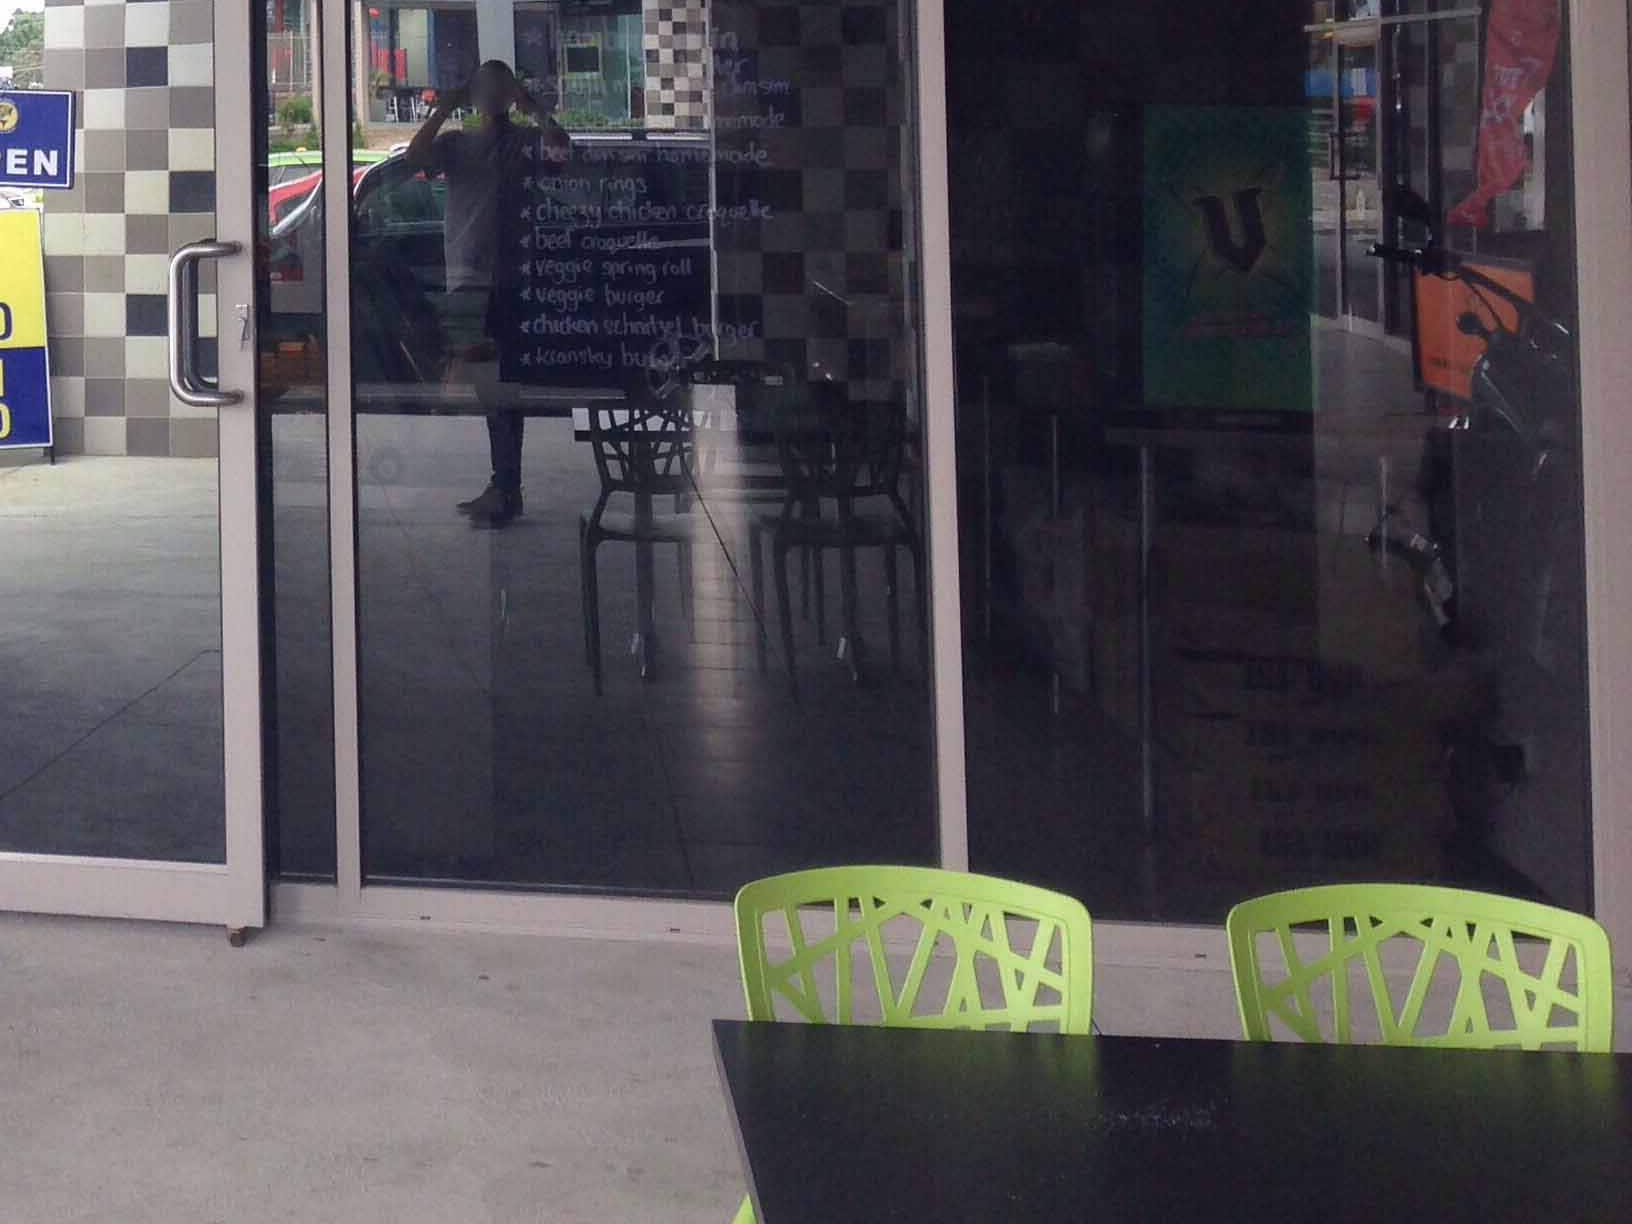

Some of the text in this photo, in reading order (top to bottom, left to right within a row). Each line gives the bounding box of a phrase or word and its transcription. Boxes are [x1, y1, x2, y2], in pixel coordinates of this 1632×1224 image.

[599, 175, 648, 200] rings
[534, 258, 593, 284] veggie
[601, 260, 657, 284] spring
[535, 284, 664, 312] veggie burger
